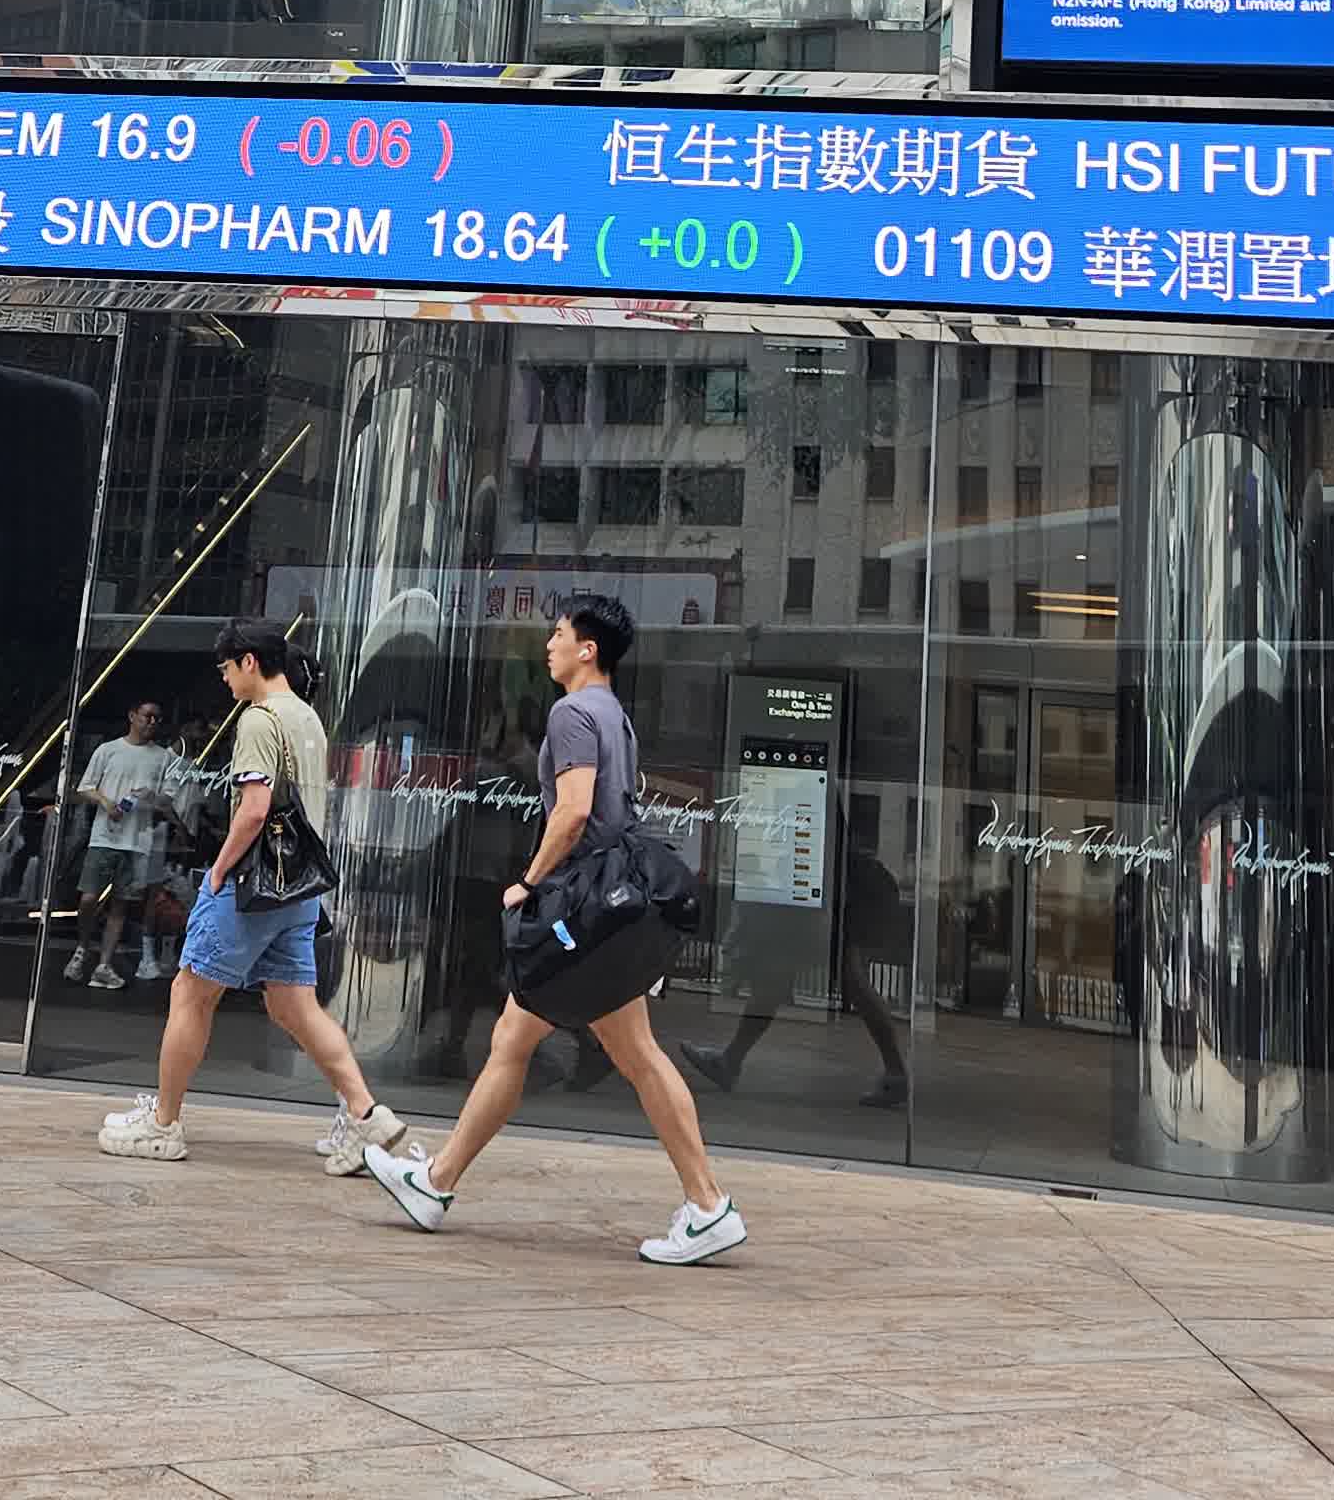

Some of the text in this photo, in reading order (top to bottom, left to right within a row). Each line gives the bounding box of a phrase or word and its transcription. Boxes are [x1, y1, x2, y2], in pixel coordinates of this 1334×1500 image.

[1051, 14, 1123, 27] omission.
[92, 112, 196, 161] 16.9
[603, 119, 1038, 199] 恒生指數期貨
[1077, 141, 1179, 192] HSI
[41, 198, 391, 255] SINOPHARM
[426, 210, 569, 261] 18.64
[875, 226, 1053, 283] 01109
[768, 708, 833, 721] Exchange Square
[790, 700, 807, 711] One
